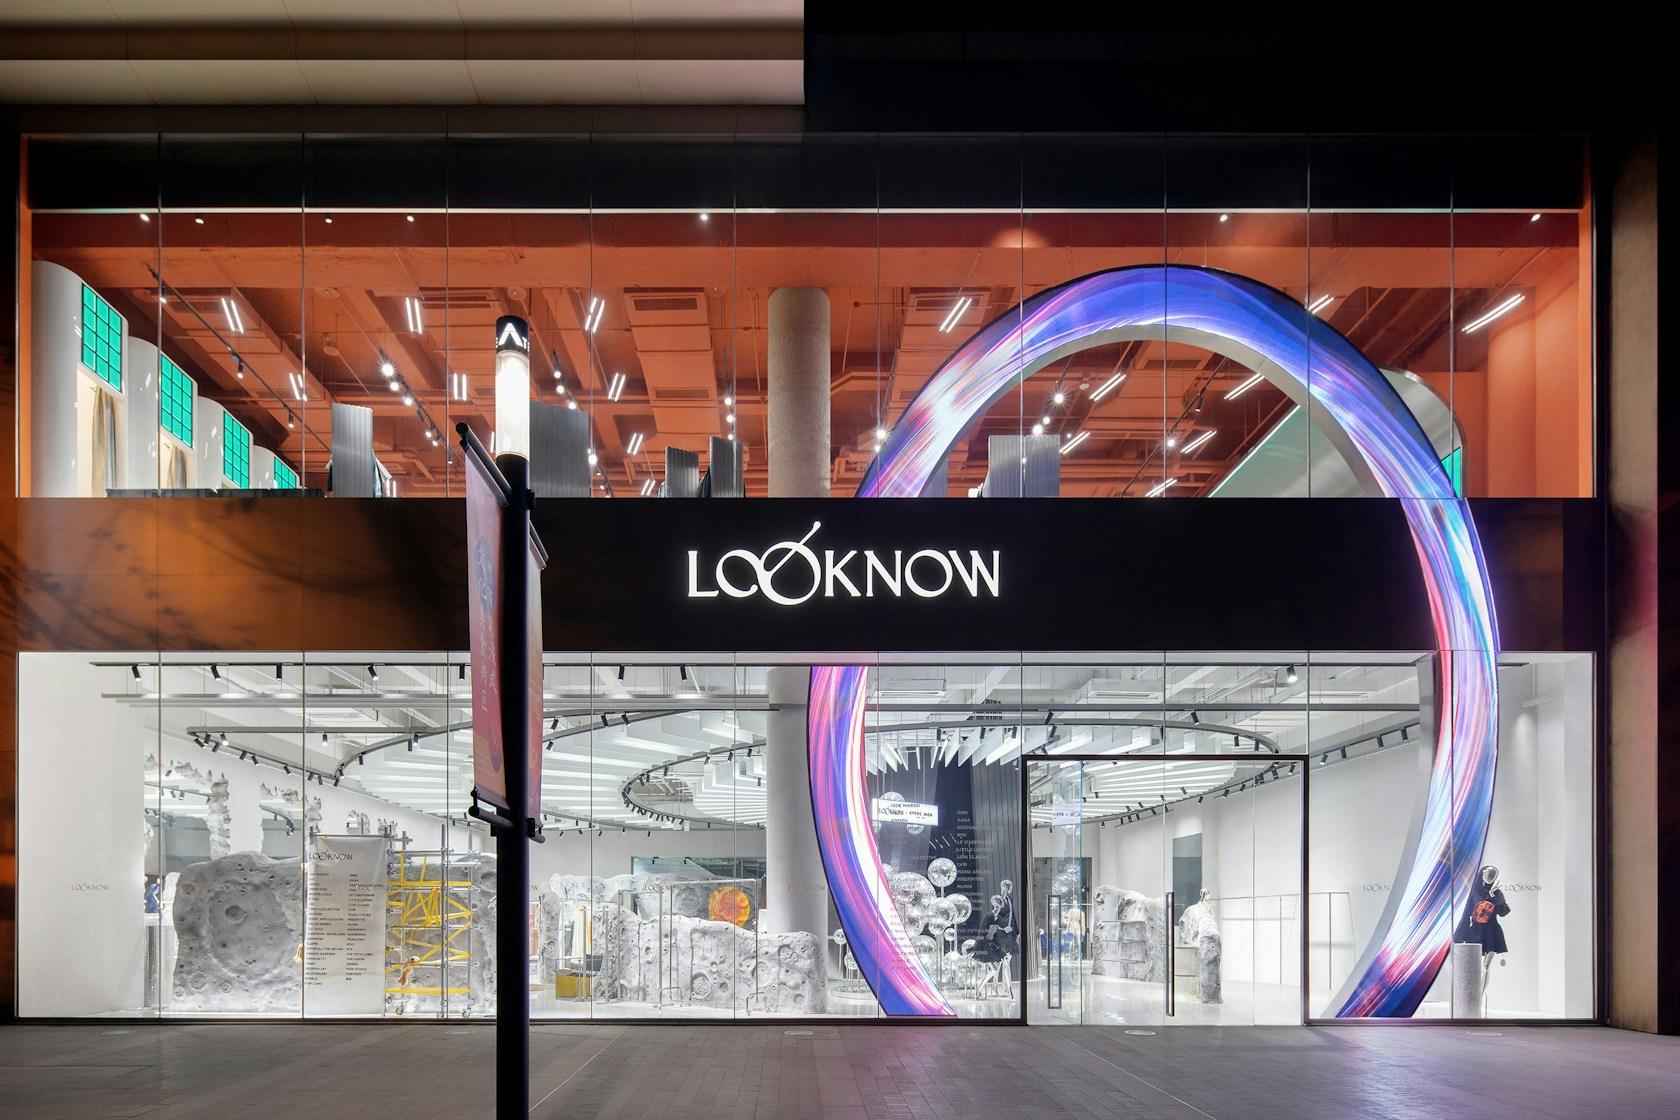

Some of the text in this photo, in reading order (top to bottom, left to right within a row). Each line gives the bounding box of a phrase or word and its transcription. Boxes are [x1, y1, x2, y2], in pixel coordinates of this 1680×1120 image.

[688, 521, 999, 605] LOOKNOW
[310, 850, 352, 861] LOOKNOW
[71, 882, 110, 892] LOOKNOW
